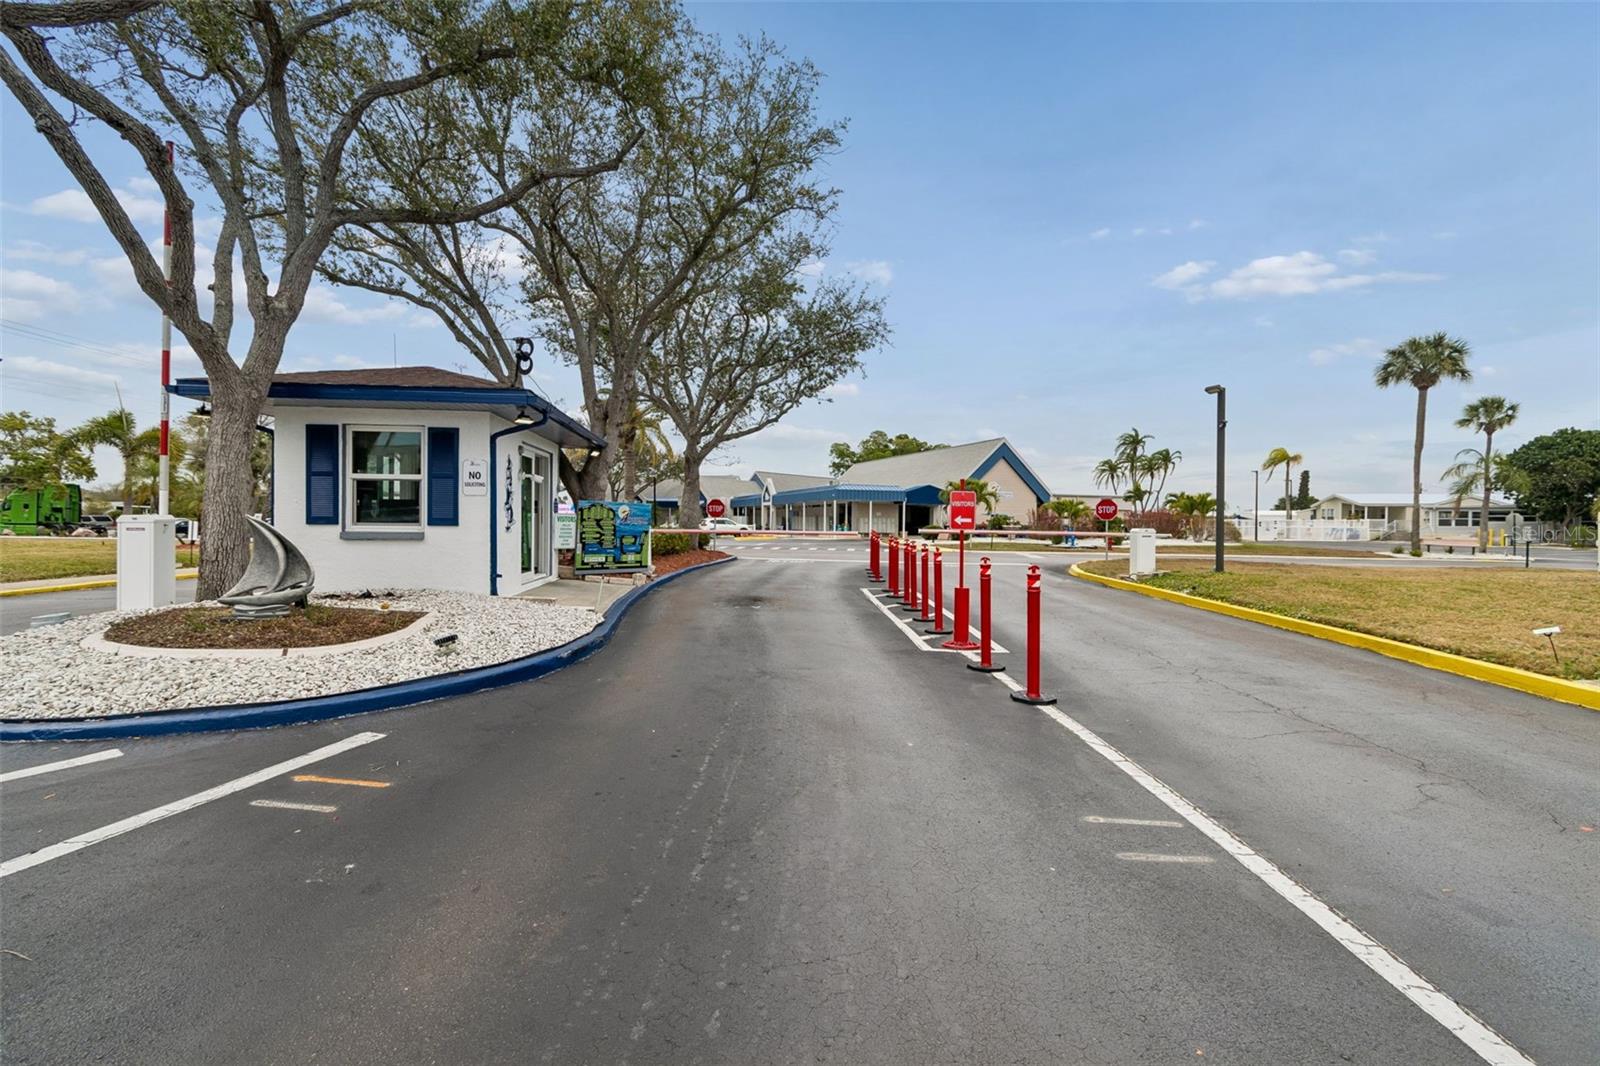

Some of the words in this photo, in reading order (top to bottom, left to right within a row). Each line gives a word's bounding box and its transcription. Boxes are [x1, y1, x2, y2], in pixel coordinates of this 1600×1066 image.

[468, 470, 482, 480] NO
[709, 504, 724, 512] STOP
[1097, 505, 1116, 514] STOP
